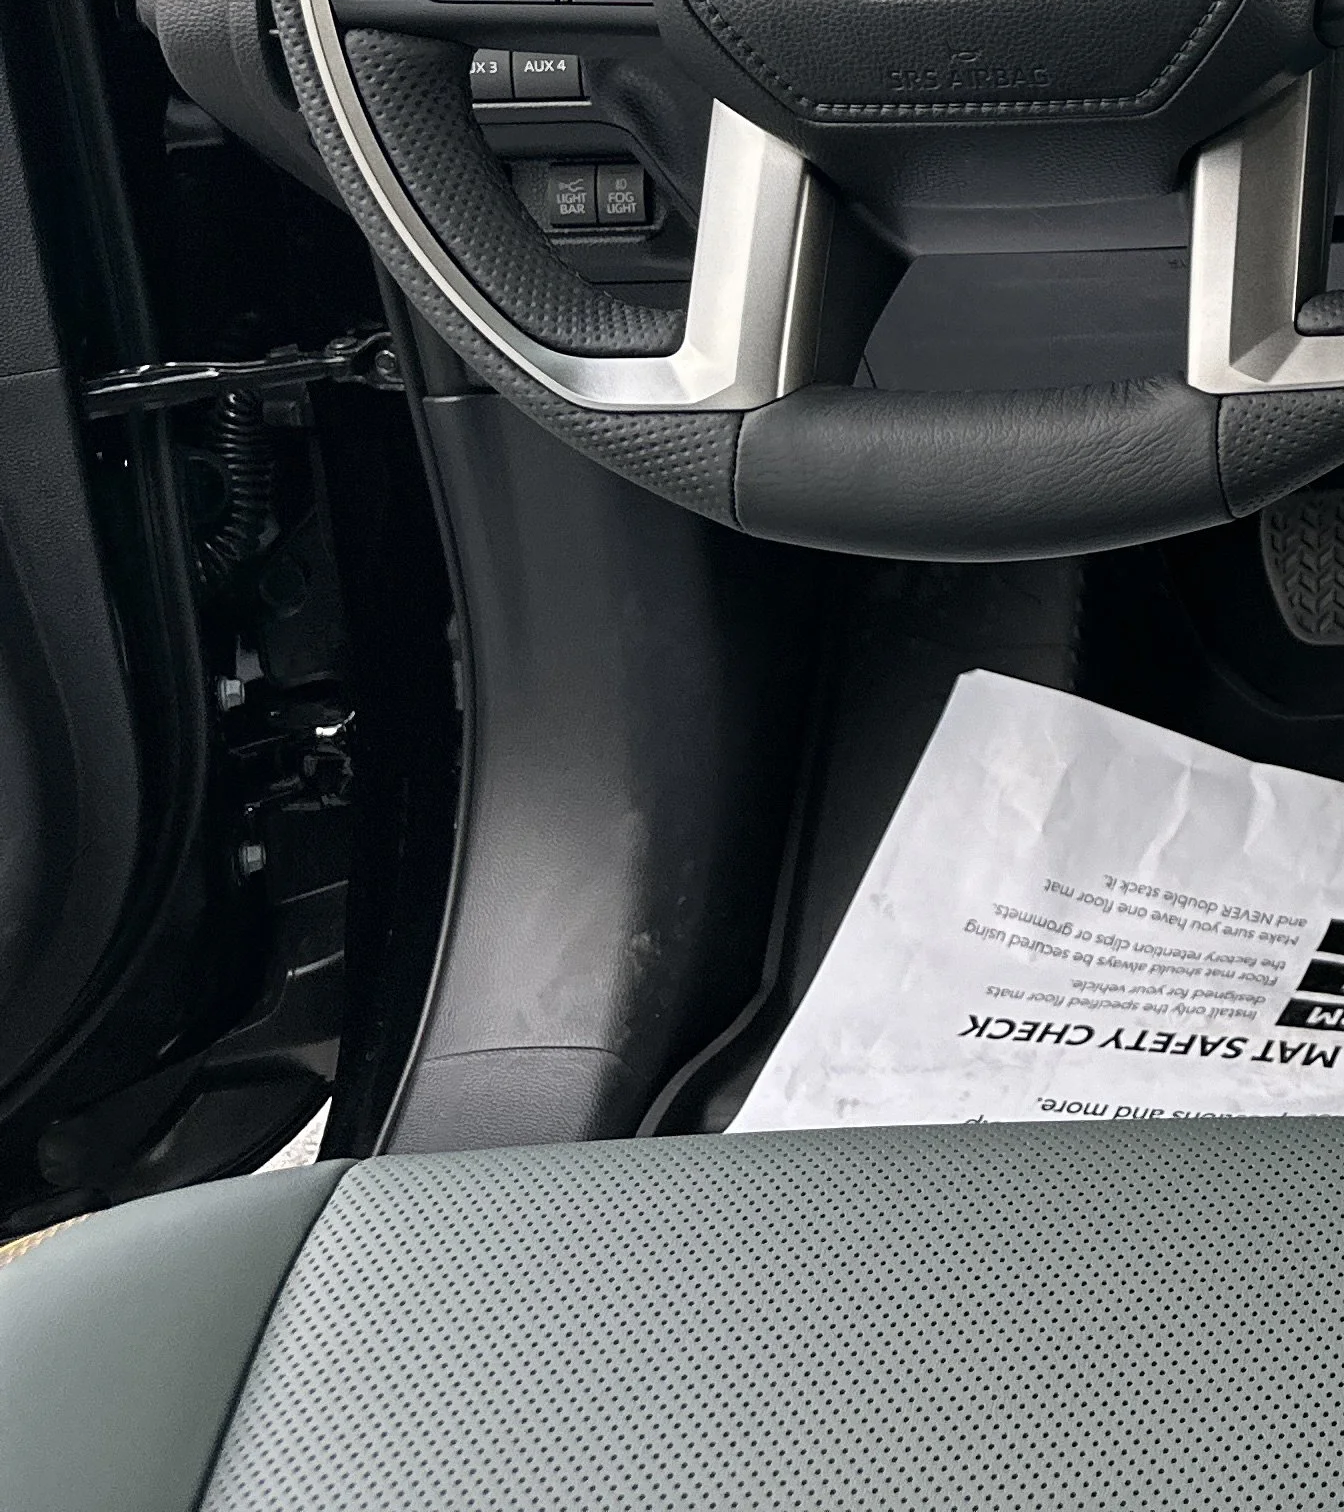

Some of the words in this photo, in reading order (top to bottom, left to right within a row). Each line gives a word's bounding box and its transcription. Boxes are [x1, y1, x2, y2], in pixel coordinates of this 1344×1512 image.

[489, 61, 498, 73] 3
[524, 61, 555, 73] AUX
[556, 59, 567, 72] 4
[556, 192, 586, 204] LIGHT
[608, 192, 635, 203] FOG
[559, 203, 585, 215] BAR
[607, 203, 636, 215] LIGHT
[1043, 878, 1075, 899] mat
[1120, 879, 1160, 900] stack
[1076, 892, 1115, 913] floor
[1163, 890, 1218, 915] double
[1118, 902, 1148, 919] one
[1220, 904, 1274, 926] NEVER
[992, 902, 1073, 938] grommets.
[1152, 910, 1187, 931] have
[1190, 920, 1221, 934] you
[1275, 915, 1307, 928] and
[964, 918, 1007, 943] using
[1074, 929, 1093, 942] or
[1222, 926, 1256, 942] sure
[1095, 933, 1131, 952] clips
[1259, 931, 1299, 946] Make
[1007, 934, 1071, 960] secured
[1133, 942, 1202, 962] retention
[1072, 951, 1094, 967] be
[1096, 956, 1147, 974] always
[1203, 951, 1257, 968] factory
[1261, 958, 1286, 971] the
[1147, 963, 1203, 977] should
[1205, 967, 1236, 979] mat
[1070, 979, 1125, 995] vehicle.
[1238, 972, 1278, 987] Floor
[986, 985, 1025, 1000] mats
[1128, 984, 1166, 995] your
[1167, 987, 1189, 1000] for
[1027, 993, 1065, 1007] floor
[1067, 997, 1139, 1012] specified
[1191, 990, 1266, 1005] designed
[1143, 1003, 1168, 1015] the
[1170, 1003, 1206, 1016] only
[1210, 1007, 1257, 1020] Install
[957, 1014, 1096, 1046] CHECK
[1098, 1027, 1249, 1059] SAFETY
[1251, 1040, 1342, 1069] MAT
[1036, 1097, 1109, 1116] more.
[1115, 1105, 1164, 1119] and
